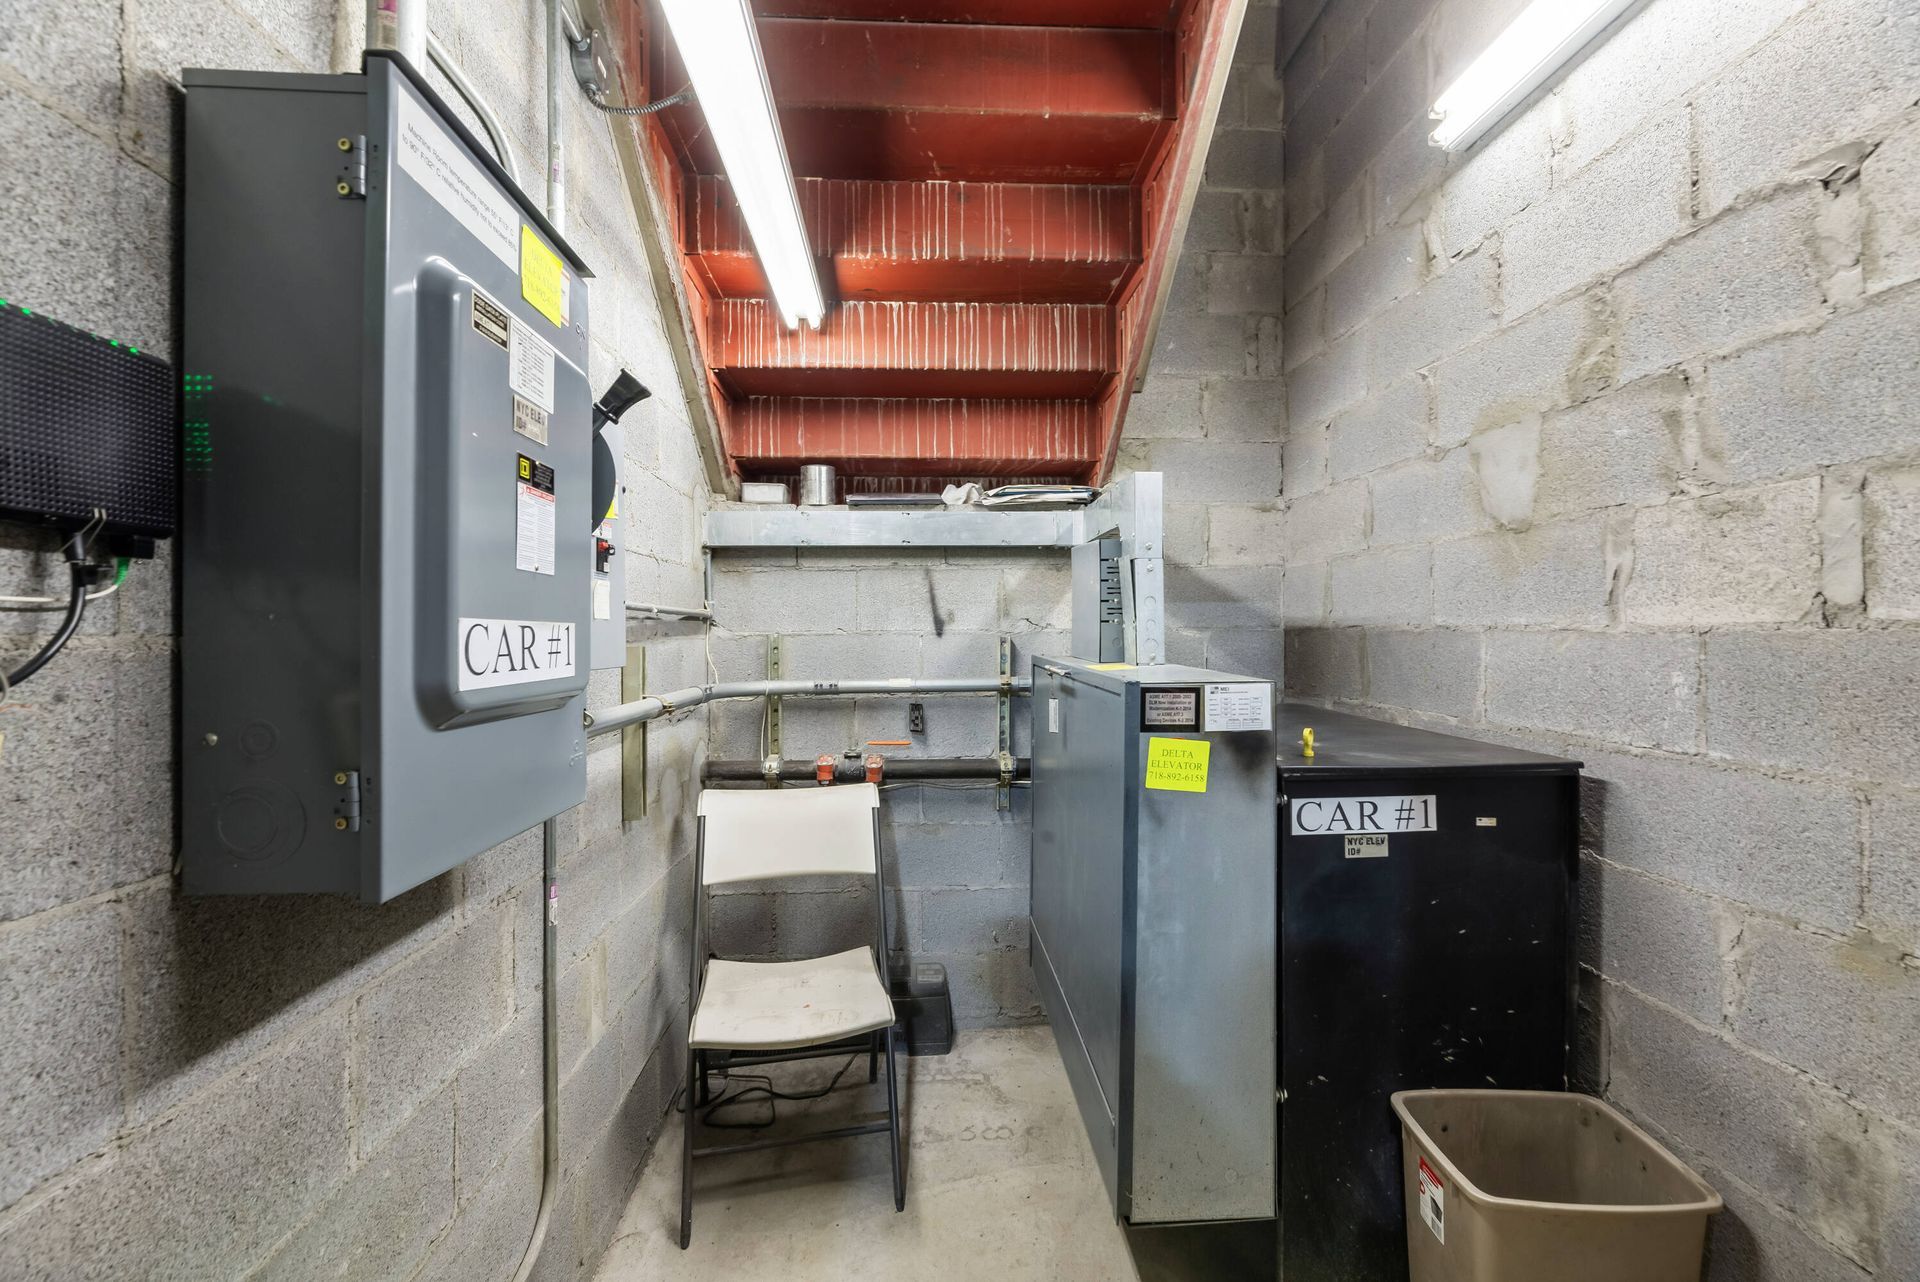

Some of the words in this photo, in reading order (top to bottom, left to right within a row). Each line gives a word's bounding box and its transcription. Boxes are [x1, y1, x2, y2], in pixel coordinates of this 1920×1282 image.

[408, 122, 431, 152] Machine
[432, 147, 448, 170] Room
[449, 164, 476, 200] temperature
[442, 172, 460, 197] relative
[460, 190, 479, 218] humidity
[492, 224, 508, 244] exceed
[464, 623, 540, 676] CAR
[547, 624, 572, 669] #1
[1162, 749, 1194, 758] DELTA
[1151, 760, 1203, 770] ELEVATOR
[1149, 770, 1205, 782] 718-892-6158
[1296, 800, 1384, 832] CAR
[1395, 799, 1433, 830] #1
[1348, 837, 1364, 846] NYC
[1366, 836, 1386, 846] ELEV
[1348, 848, 1360, 856] ID#
